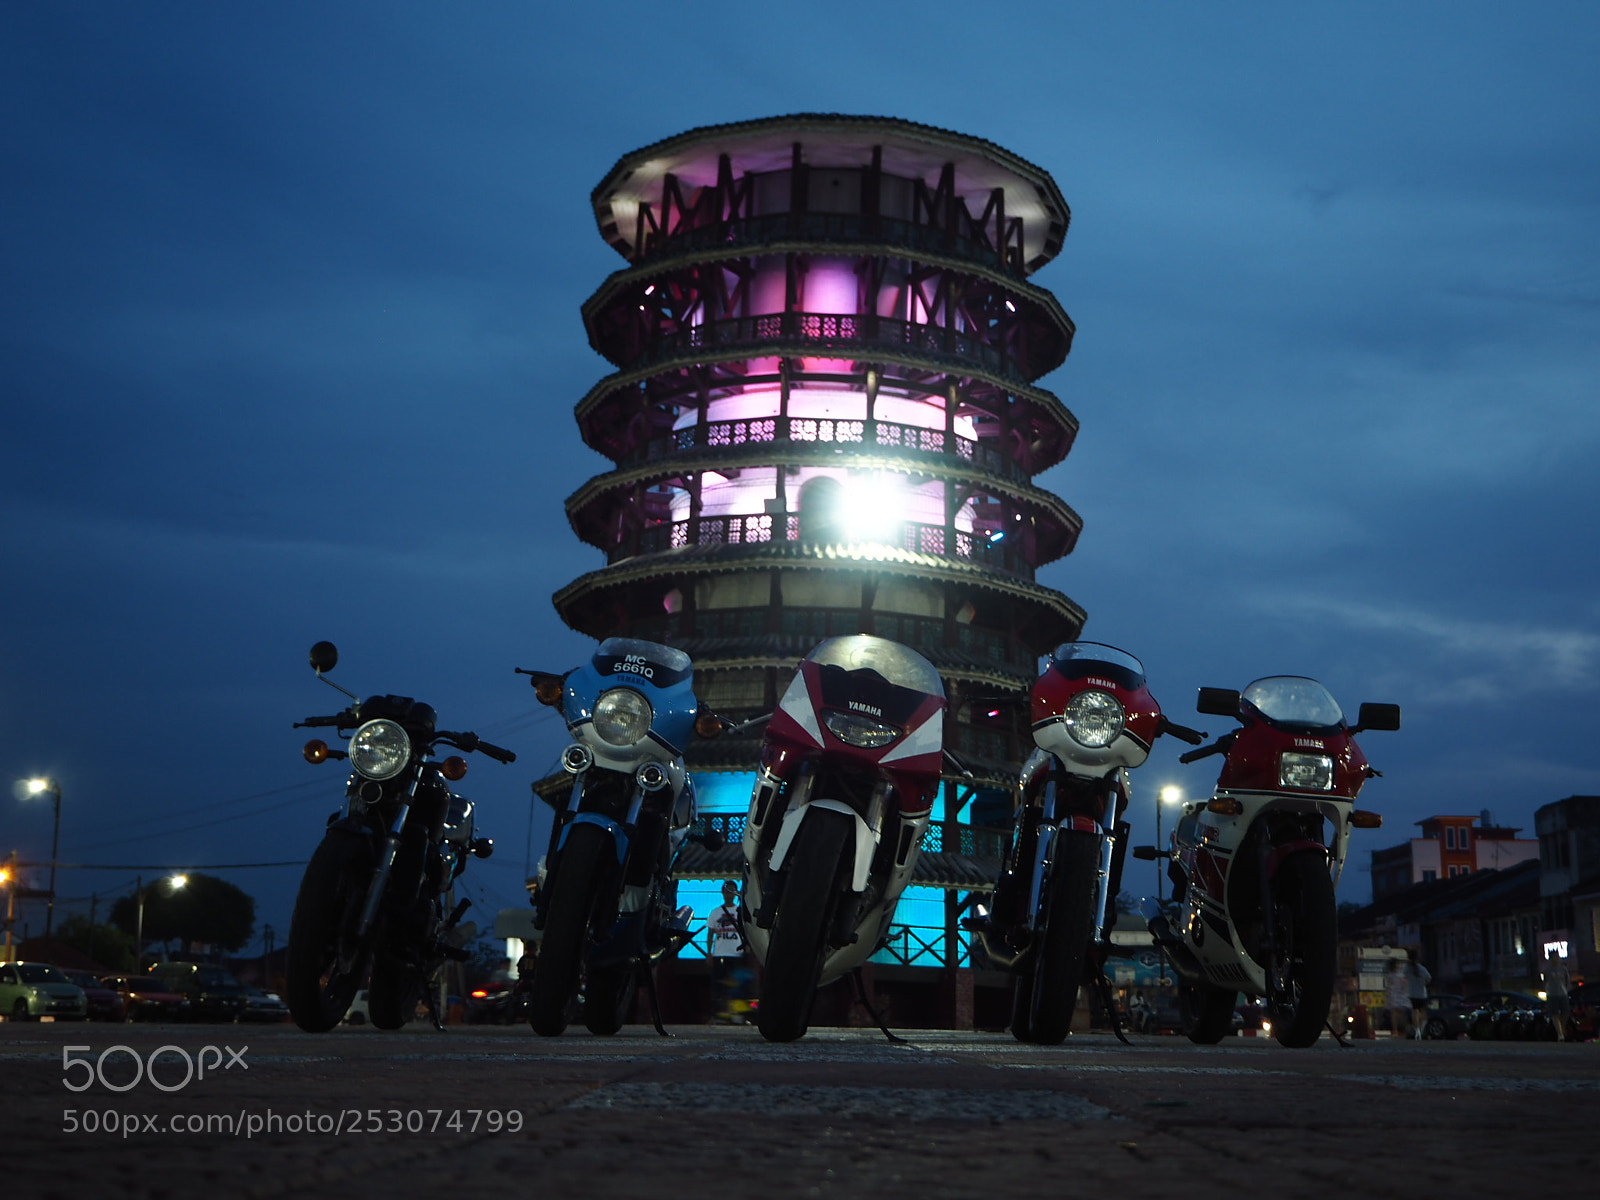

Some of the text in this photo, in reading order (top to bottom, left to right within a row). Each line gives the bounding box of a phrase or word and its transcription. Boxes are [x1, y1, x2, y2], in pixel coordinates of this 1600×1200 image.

[625, 655, 646, 665] MC
[613, 663, 654, 678] 5661Q
[1087, 677, 1116, 690] YAMAHA
[849, 701, 882, 717] YAMAHA
[1294, 737, 1325, 749] YAMAHA
